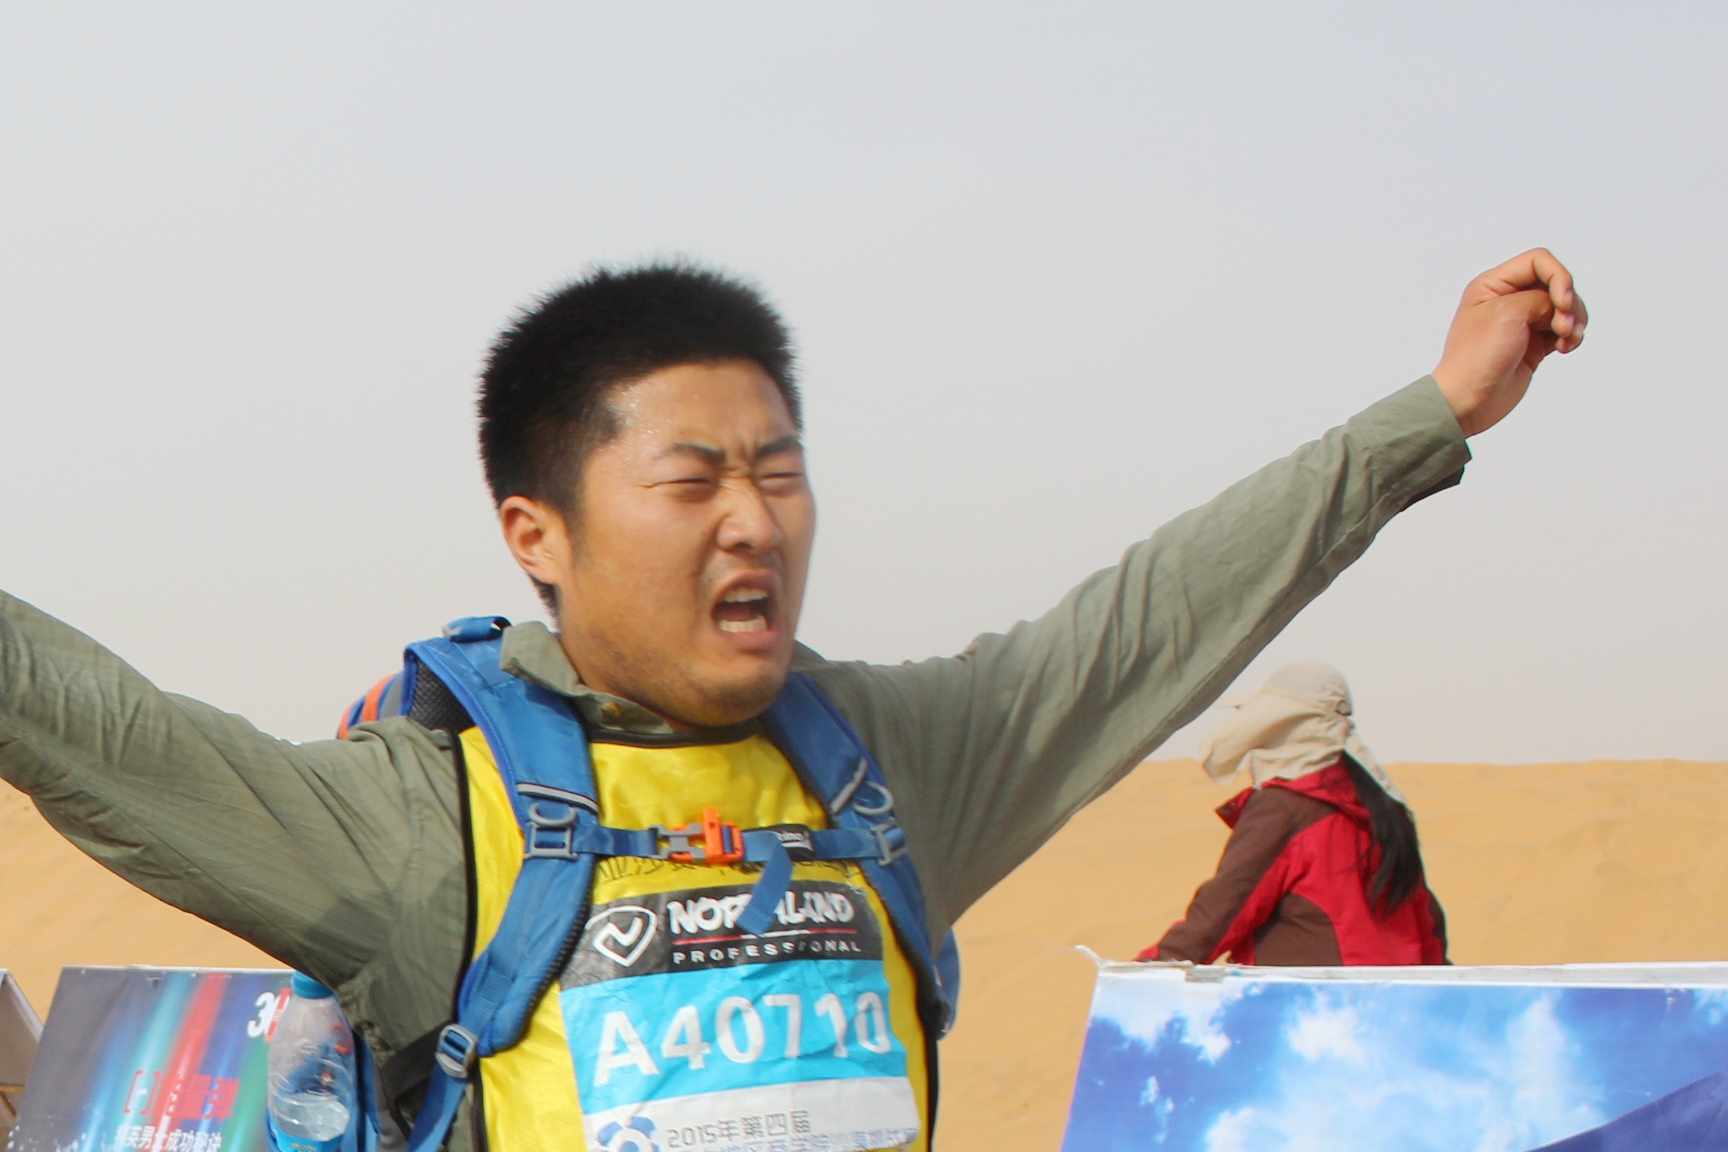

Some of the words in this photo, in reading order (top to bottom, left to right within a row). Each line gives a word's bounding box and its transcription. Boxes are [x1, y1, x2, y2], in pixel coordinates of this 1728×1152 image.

[672, 939, 862, 965] PROFESSIONAL
[593, 991, 891, 1088] A40710
[666, 1109, 812, 1149] 2015年第四届
